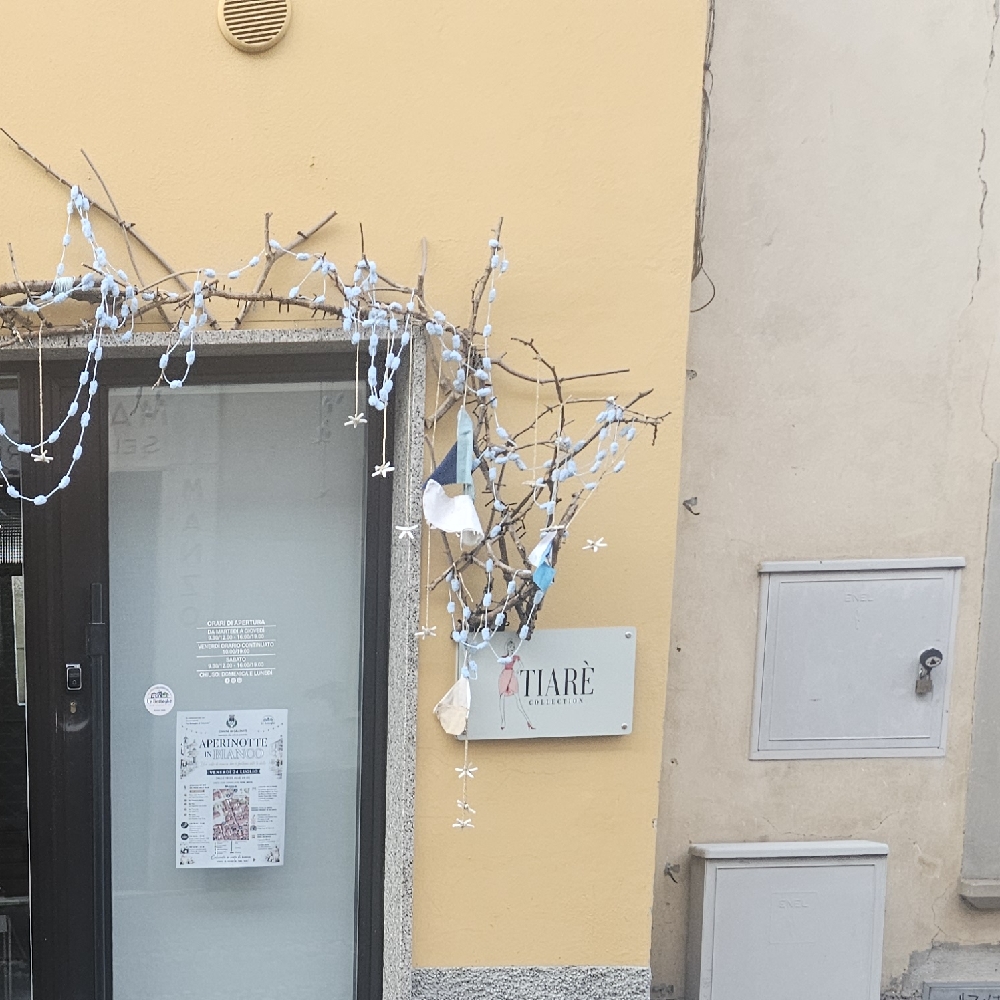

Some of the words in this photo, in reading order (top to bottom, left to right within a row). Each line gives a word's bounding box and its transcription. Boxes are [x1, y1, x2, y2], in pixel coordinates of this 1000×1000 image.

[844, 593, 874, 602] ENEL
[519, 660, 595, 697] TIARÈ
[528, 698, 584, 706] COLLECTION
[199, 738, 268, 748] APERINOTTE
[212, 748, 265, 760] BIANCO
[779, 899, 809, 909] ENEL
